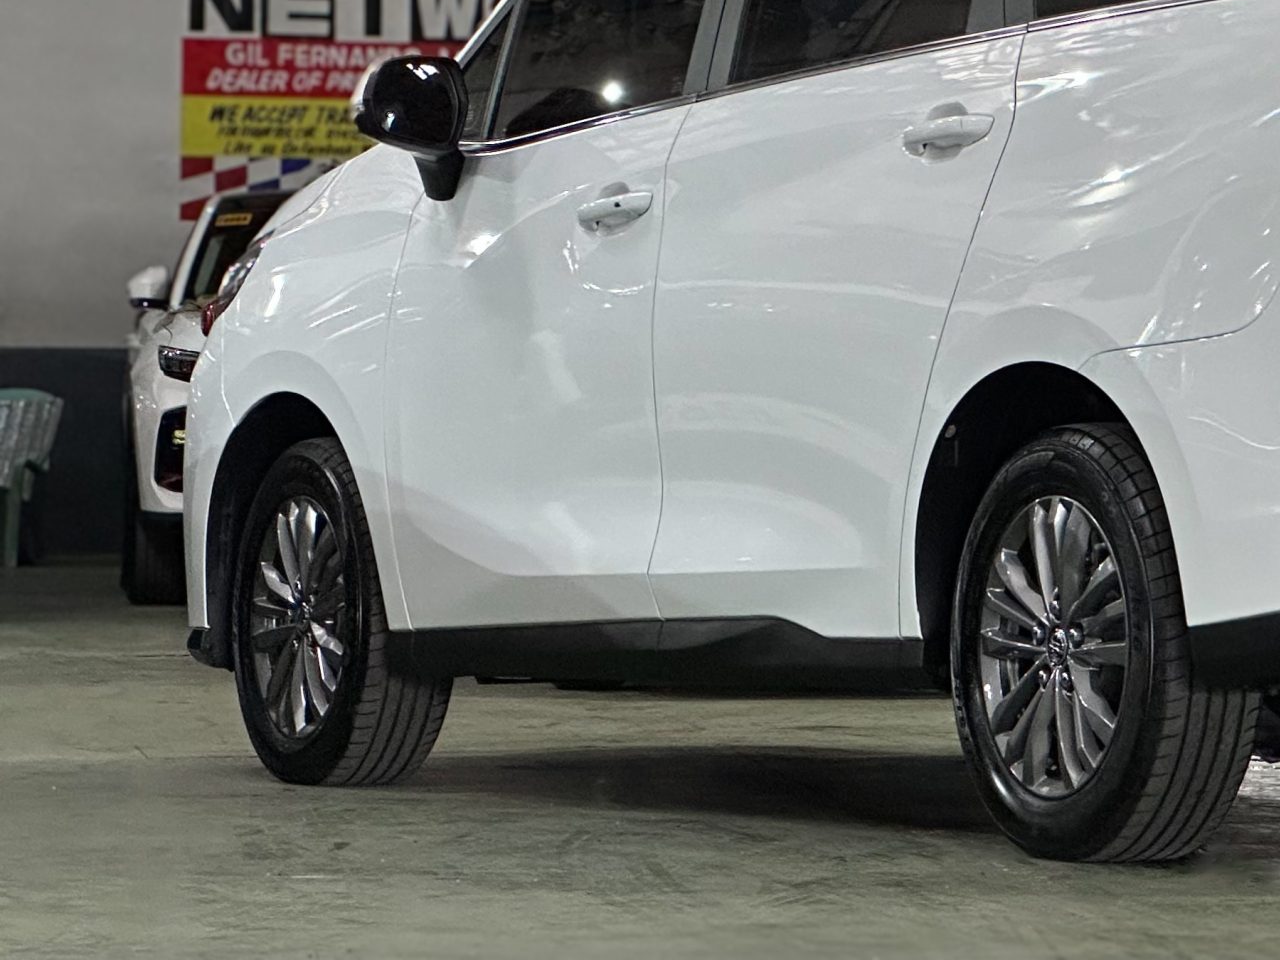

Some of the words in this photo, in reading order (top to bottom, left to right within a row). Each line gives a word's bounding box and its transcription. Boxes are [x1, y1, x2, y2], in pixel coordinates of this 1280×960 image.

[225, 43, 269, 66] GIL
[206, 69, 290, 92] DEALER
[292, 71, 323, 93] OF
[241, 105, 308, 122] ACCEPT
